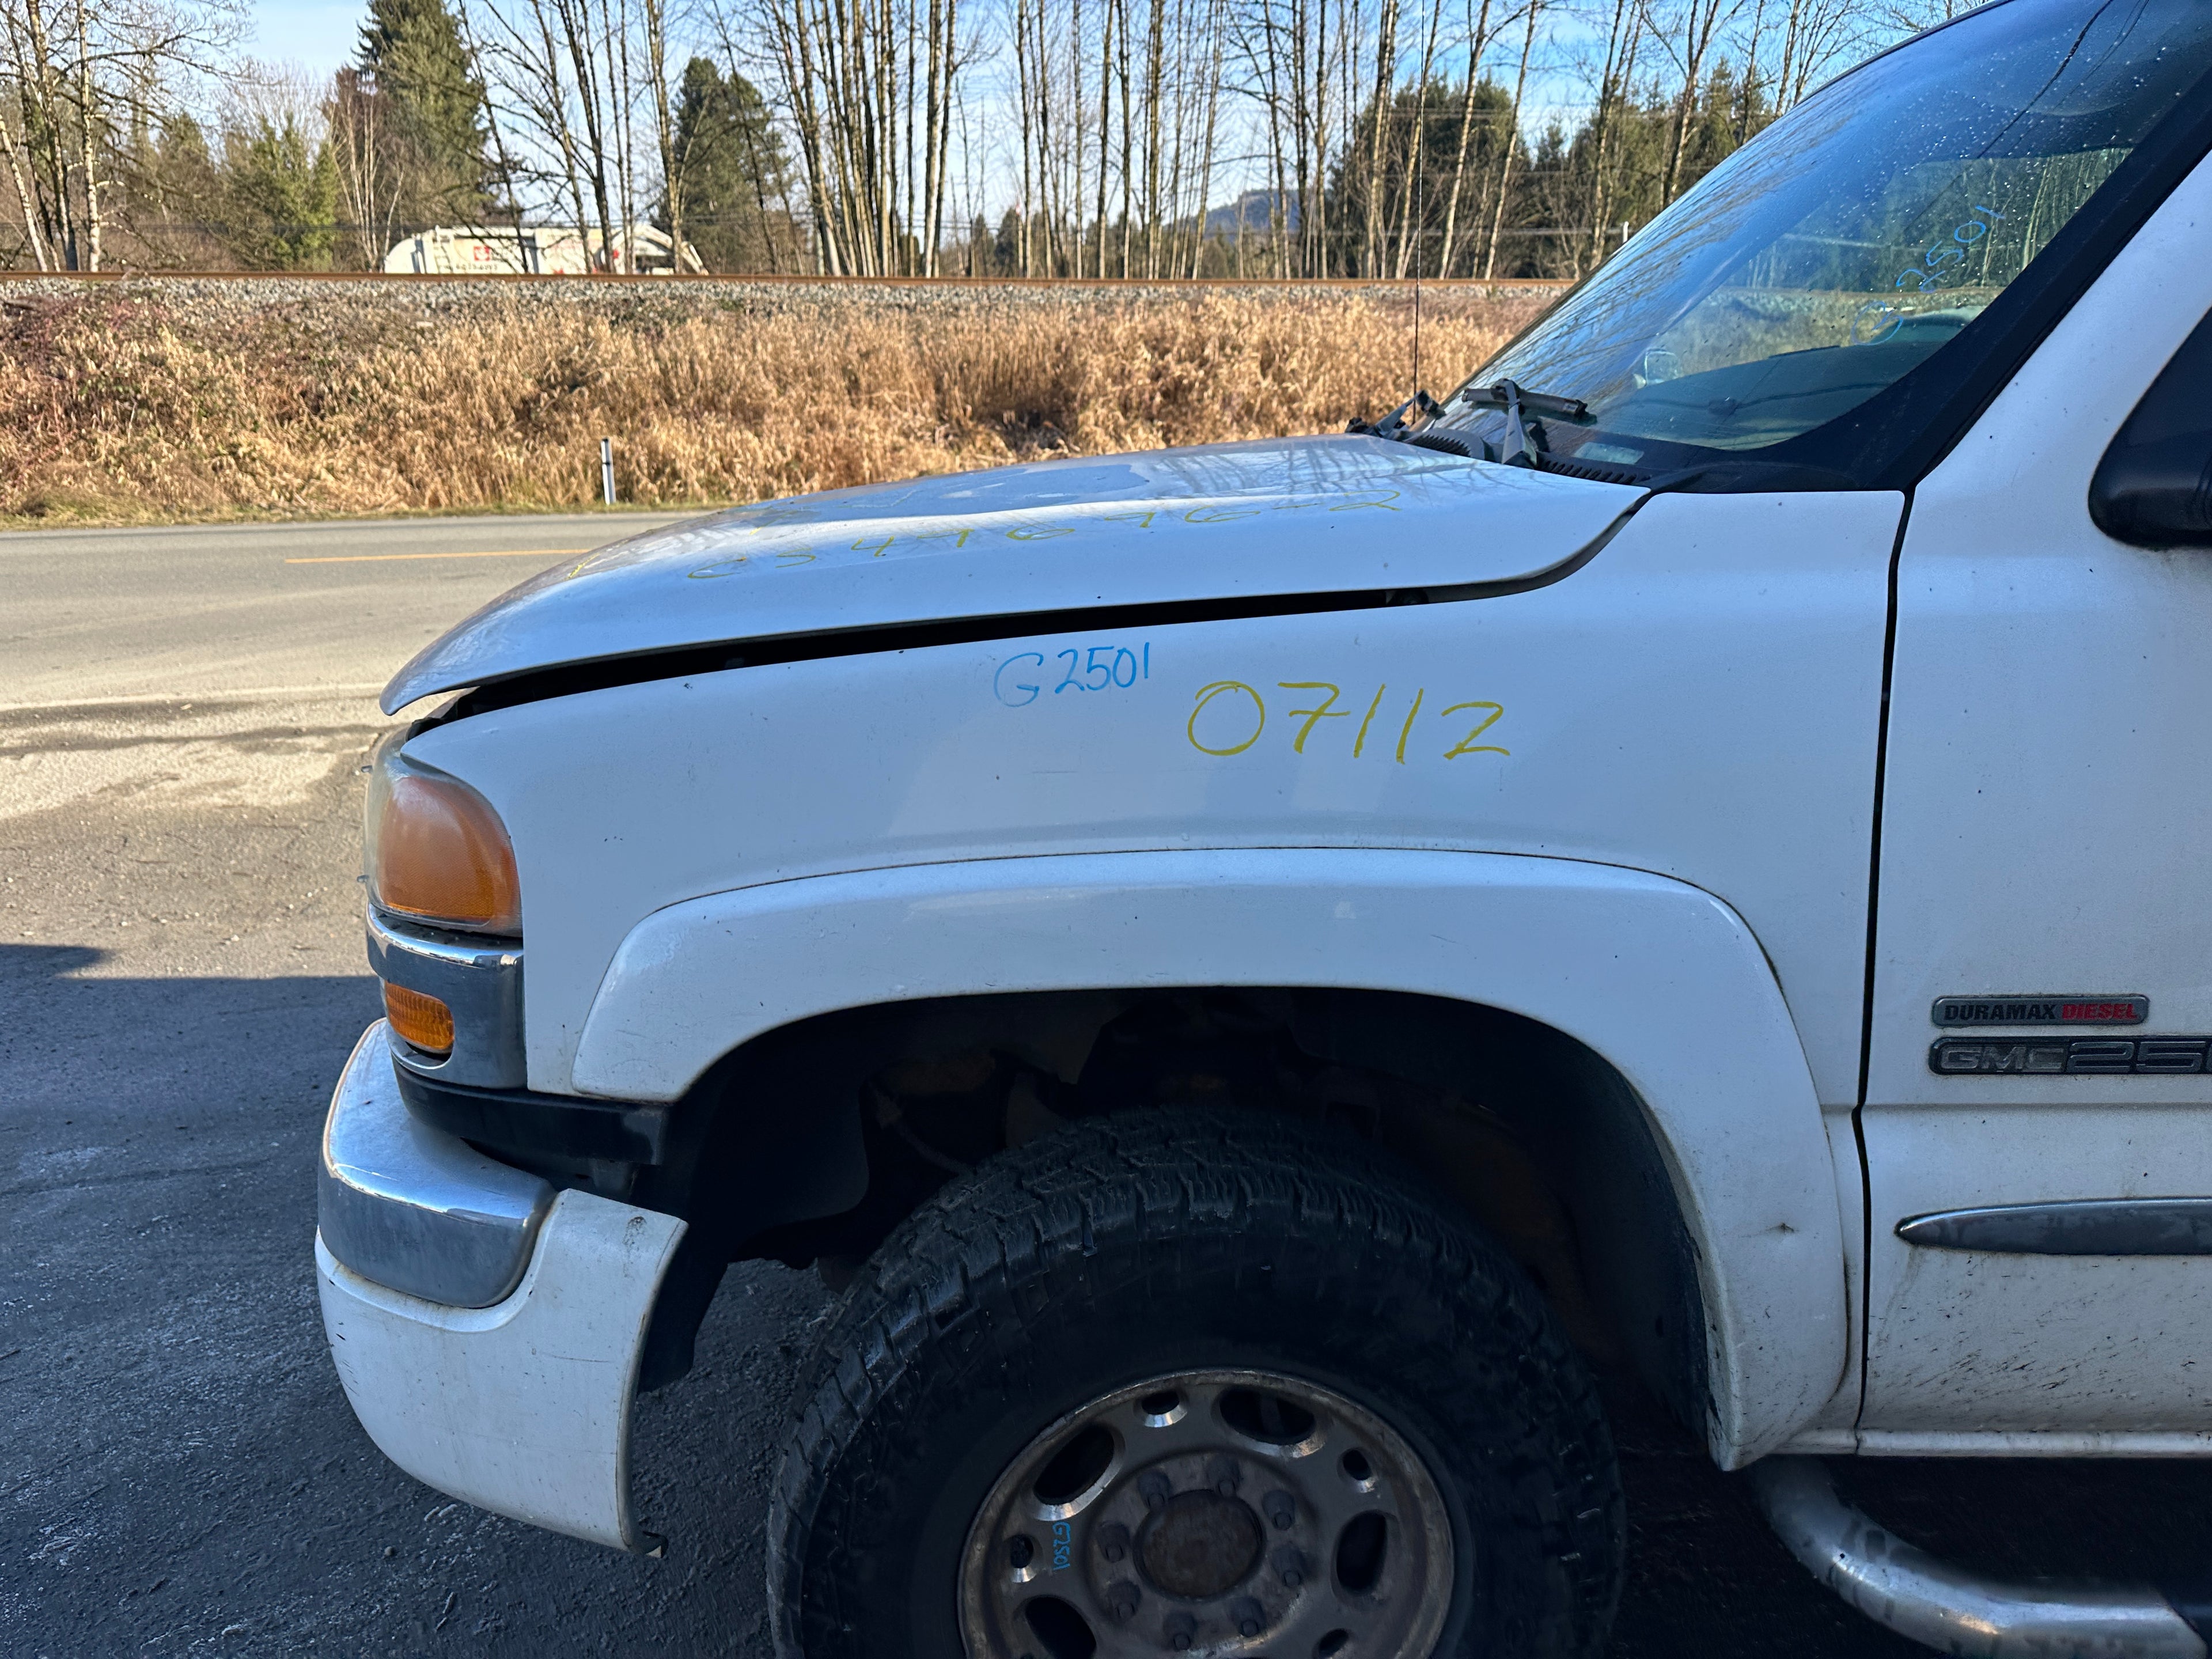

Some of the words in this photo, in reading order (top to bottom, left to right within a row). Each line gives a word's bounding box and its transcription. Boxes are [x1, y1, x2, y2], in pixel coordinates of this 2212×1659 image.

[993, 641, 1150, 708] G2501
[1943, 1003, 2056, 1021] DURAMAX
[2061, 1003, 2139, 1020] DIESEL
